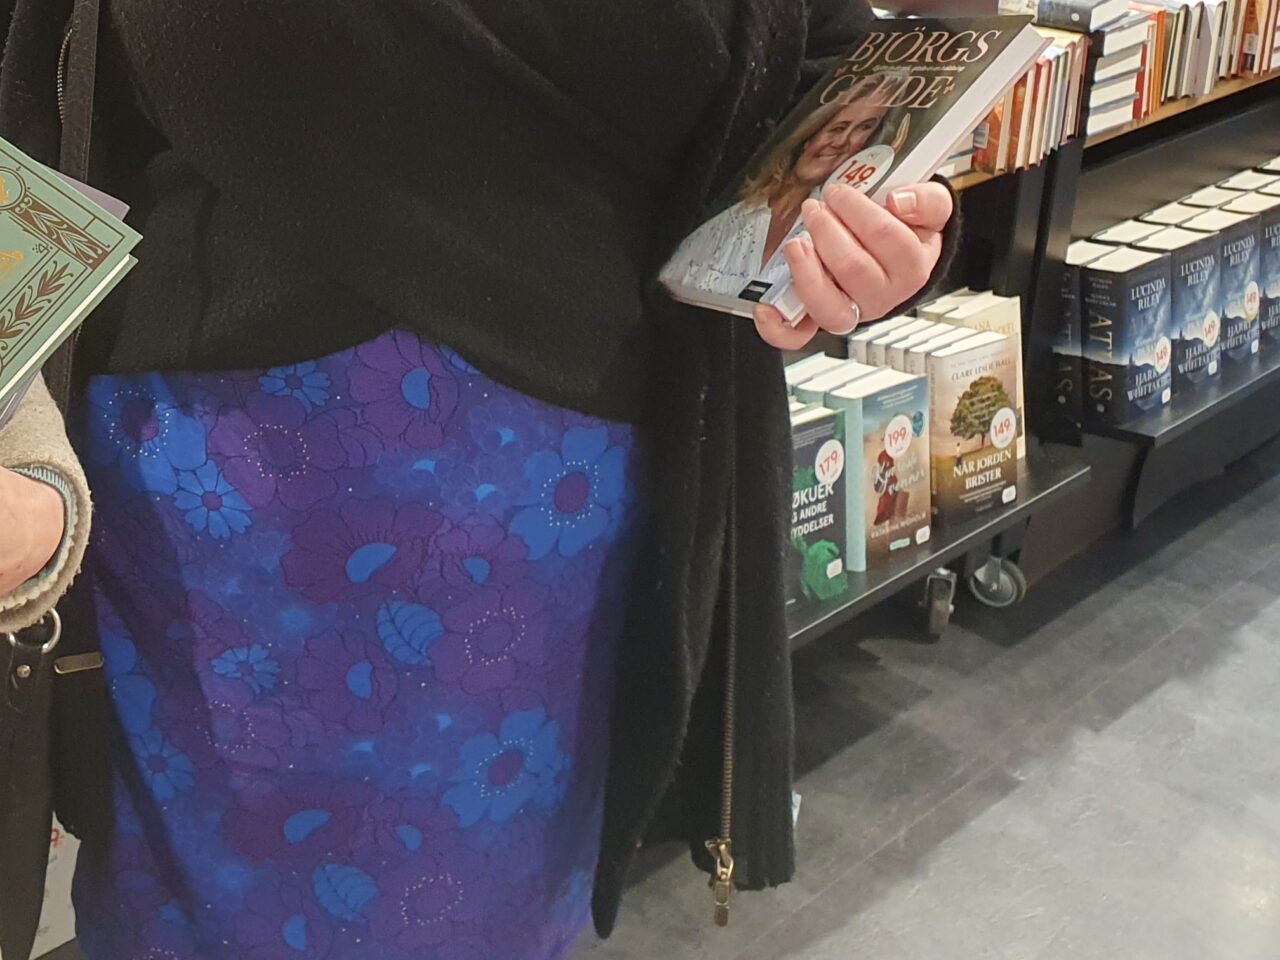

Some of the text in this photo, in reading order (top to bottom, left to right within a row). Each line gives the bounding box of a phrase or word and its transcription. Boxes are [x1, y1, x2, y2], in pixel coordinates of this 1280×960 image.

[847, 26, 1002, 72] BJÖRGS
[1224, 235, 1256, 257] LUCINDA
[1180, 254, 1215, 277] LUCINDA
[1230, 250, 1251, 268] RILEY
[1131, 277, 1166, 300] LUCINDA
[1187, 269, 1210, 287] RILEY
[1138, 292, 1162, 311] RILEY
[953, 447, 1012, 478] NÅR JORDEN
[965, 466, 1002, 490] BRISTER
[792, 482, 834, 508] ØKUER
[800, 501, 827, 520] ANDRE
[791, 513, 834, 539] YDDELSER
